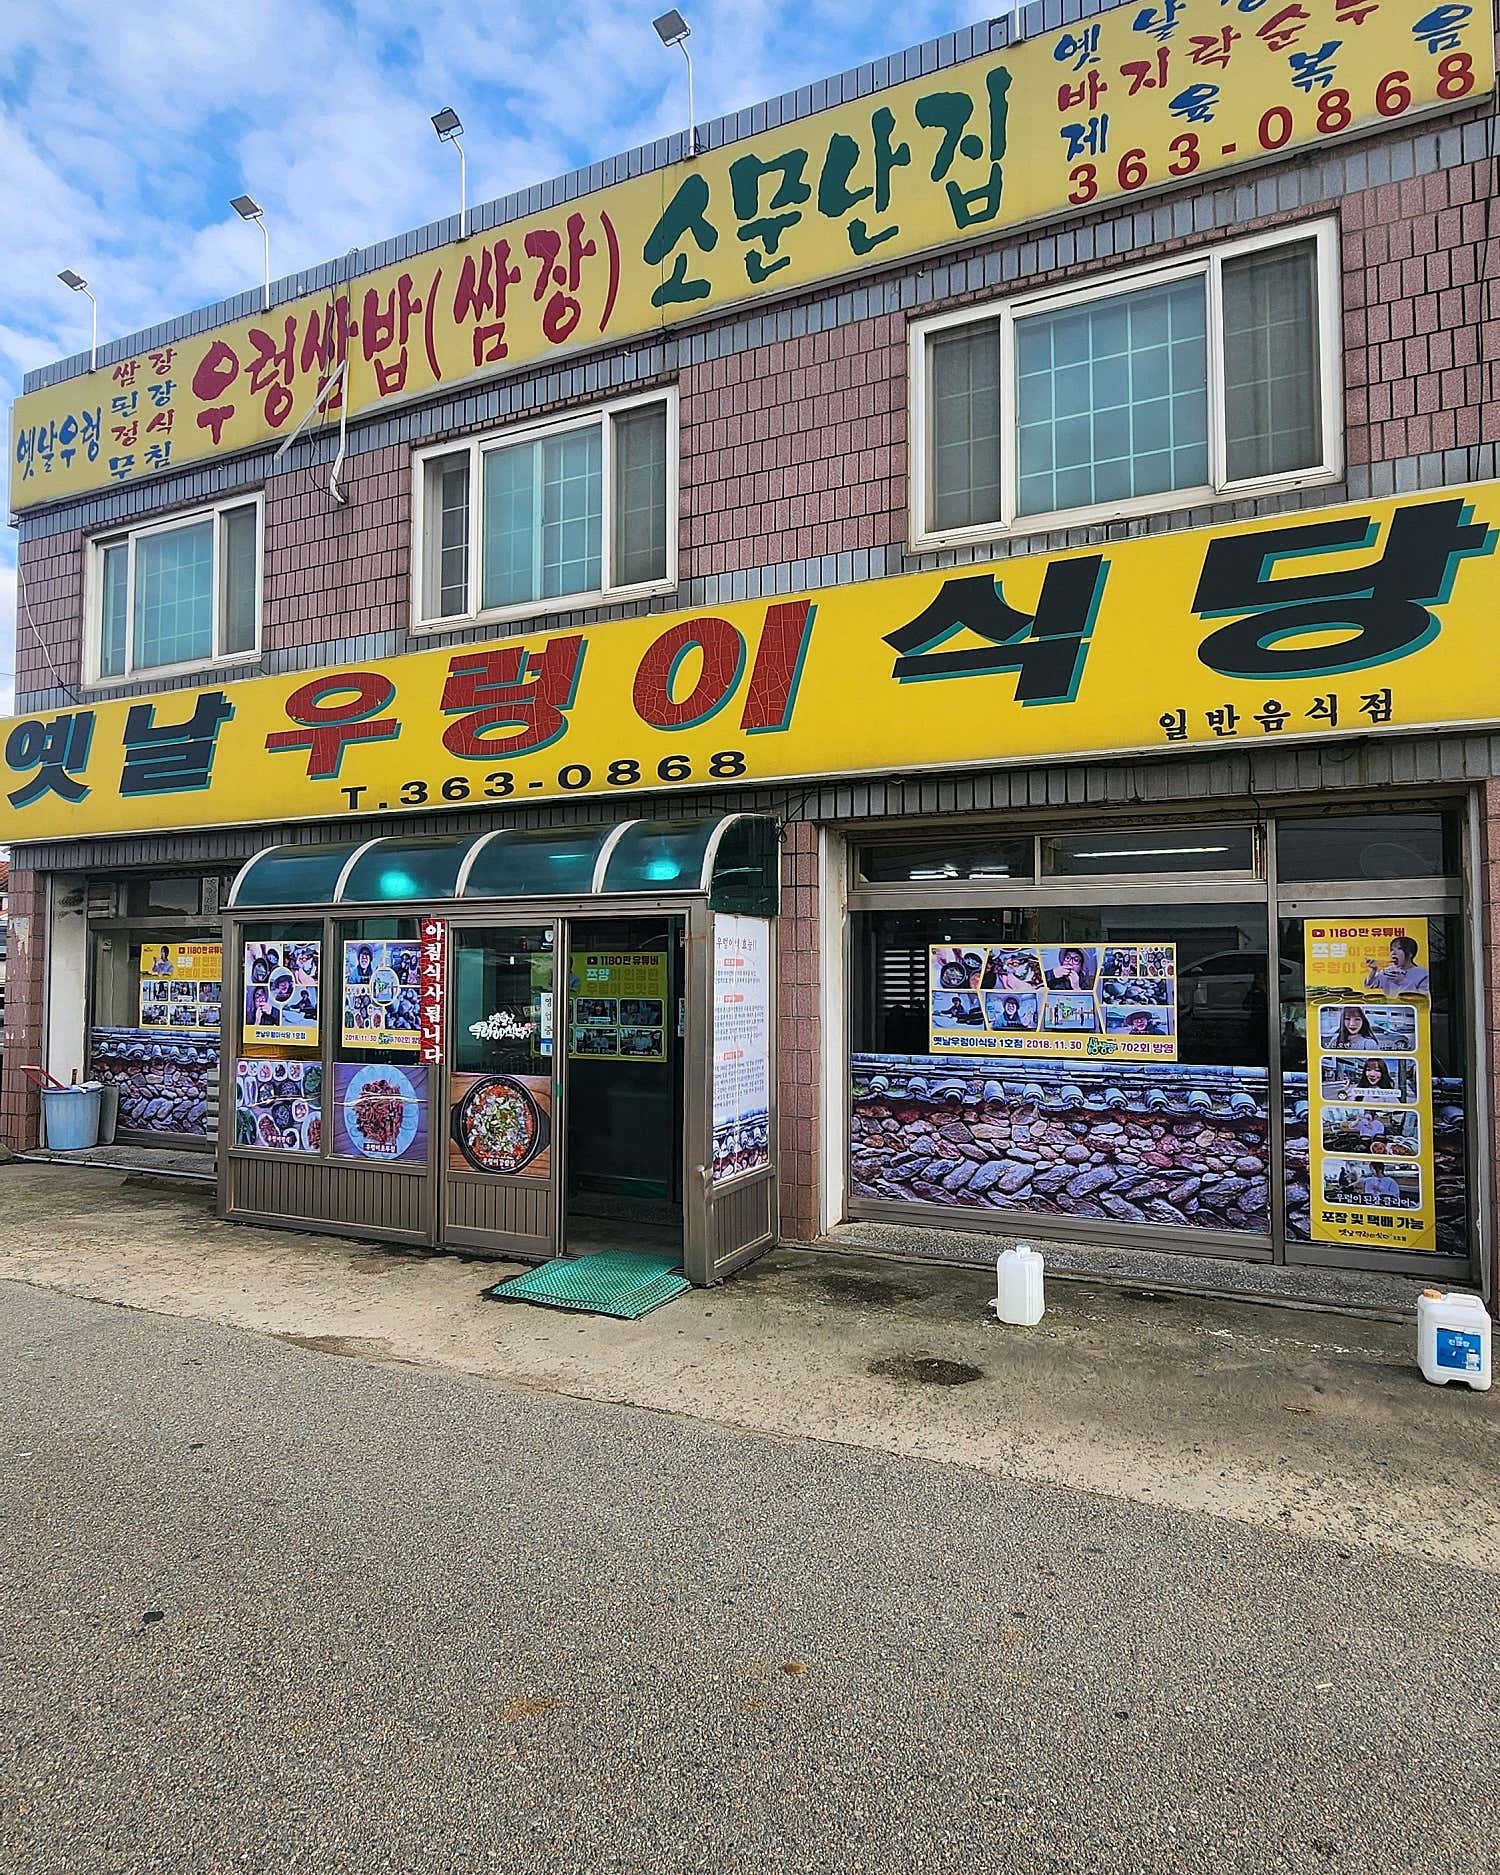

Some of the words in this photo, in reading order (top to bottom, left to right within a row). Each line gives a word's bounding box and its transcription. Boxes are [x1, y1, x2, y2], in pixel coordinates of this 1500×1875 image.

[643, 66, 1012, 307] 소문난집
[1067, 52, 1476, 204] 363-0868
[1159, 689, 1394, 740] 일반음식점
